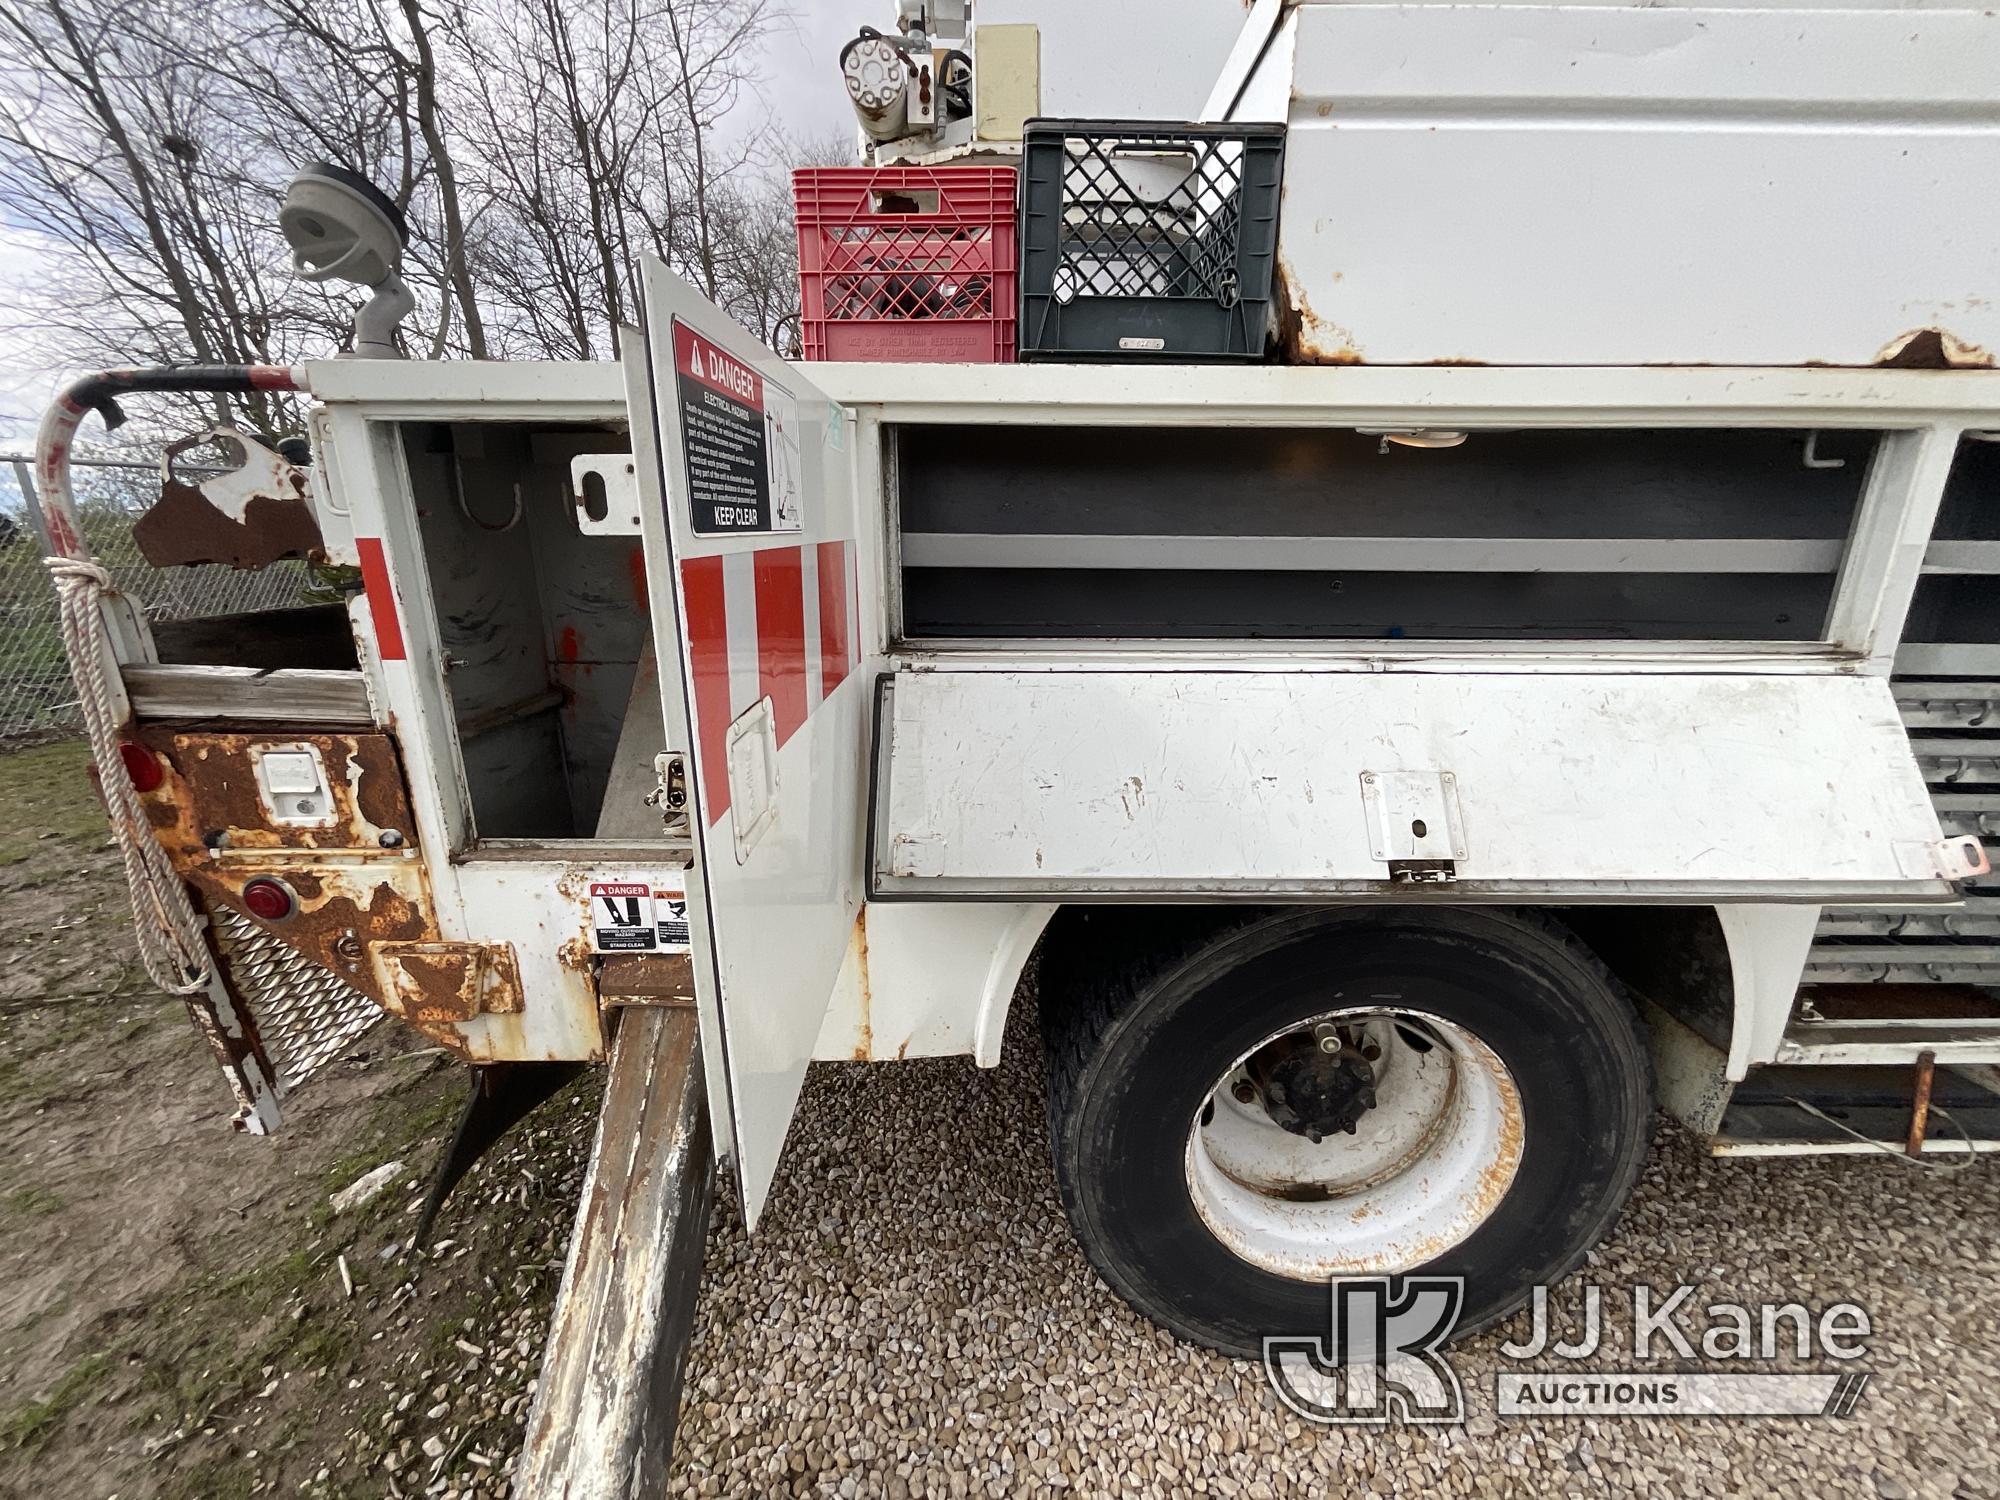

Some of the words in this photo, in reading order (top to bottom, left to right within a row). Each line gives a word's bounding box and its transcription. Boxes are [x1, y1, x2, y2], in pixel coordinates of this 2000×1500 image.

[708, 350, 755, 401] DANGER
[704, 391, 731, 413] ELECTRICAL
[731, 404, 749, 421] HAZARDS
[714, 506, 735, 526] KEEP
[736, 507, 758, 526] CLEAR
[608, 887, 644, 895] DANGER
